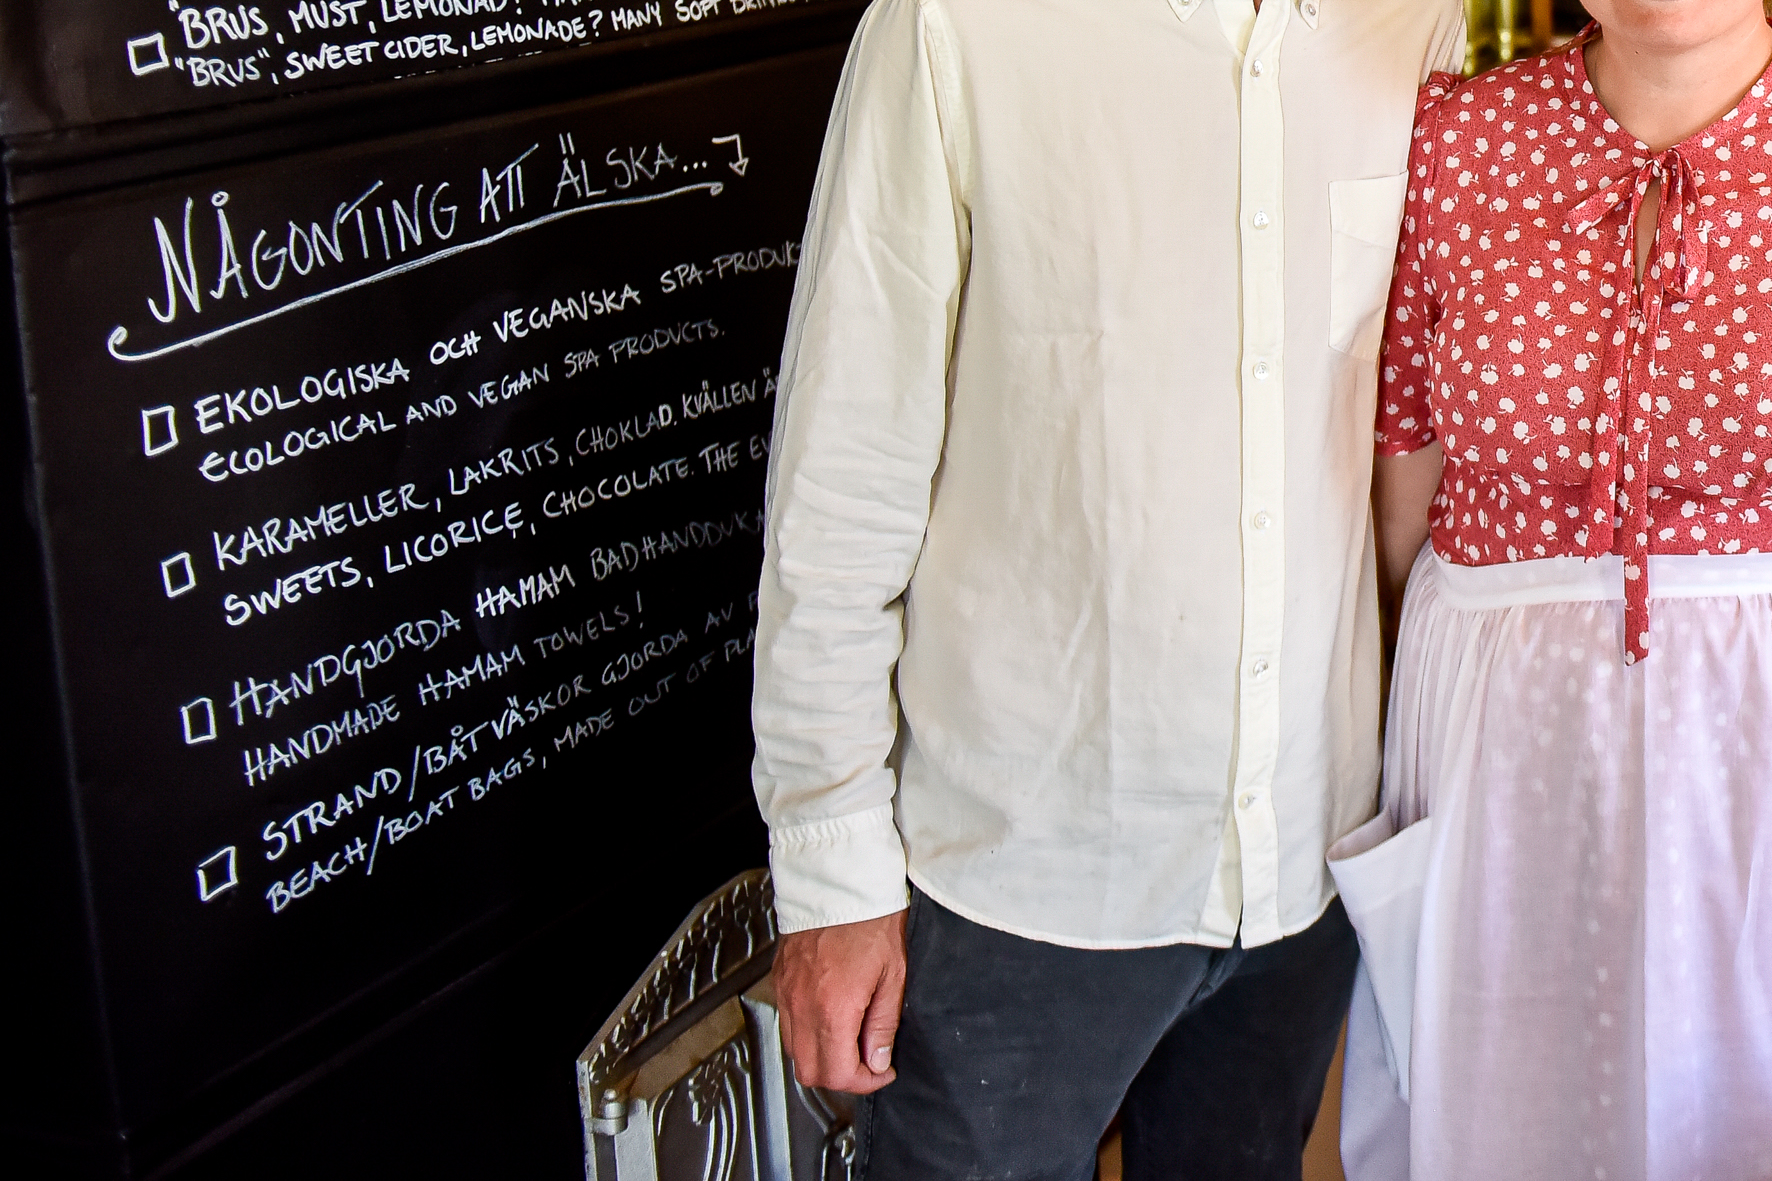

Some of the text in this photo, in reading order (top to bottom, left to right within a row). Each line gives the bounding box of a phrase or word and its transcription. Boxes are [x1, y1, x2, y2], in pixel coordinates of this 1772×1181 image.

[284, 41, 379, 79] SWEET
[384, 34, 467, 59] CIDER,
[471, 10, 602, 50] LEMONADE?
[611, 1, 662, 31] MANY
[147, 180, 457, 323] NÅGONTING
[480, 143, 539, 223] ATT
[194, 241, 799, 434] EKOLOGISKA OCH VEGANSKA SPA-PRODUK
[198, 411, 396, 482] ECOLOGICAL
[406, 395, 457, 424] AND
[468, 364, 549, 408] VEGAN
[564, 349, 599, 378] SPA
[682, 379, 755, 419] KVÄLLEN
[223, 557, 373, 626] SWEETS,
[699, 442, 739, 473] THE
[229, 610, 461, 726] HANDGJORDA
[476, 565, 575, 618] HAMAM
[243, 591, 643, 786] HANDMADE HAMAM TOWELS!
[467, 748, 546, 801] BAGS,
[554, 709, 614, 751] MADE
[628, 673, 676, 716] OUT
[687, 651, 714, 683] OF
[726, 629, 754, 661] PLA
[602, 630, 687, 685] GJORDA
[705, 603, 733, 633] AV
